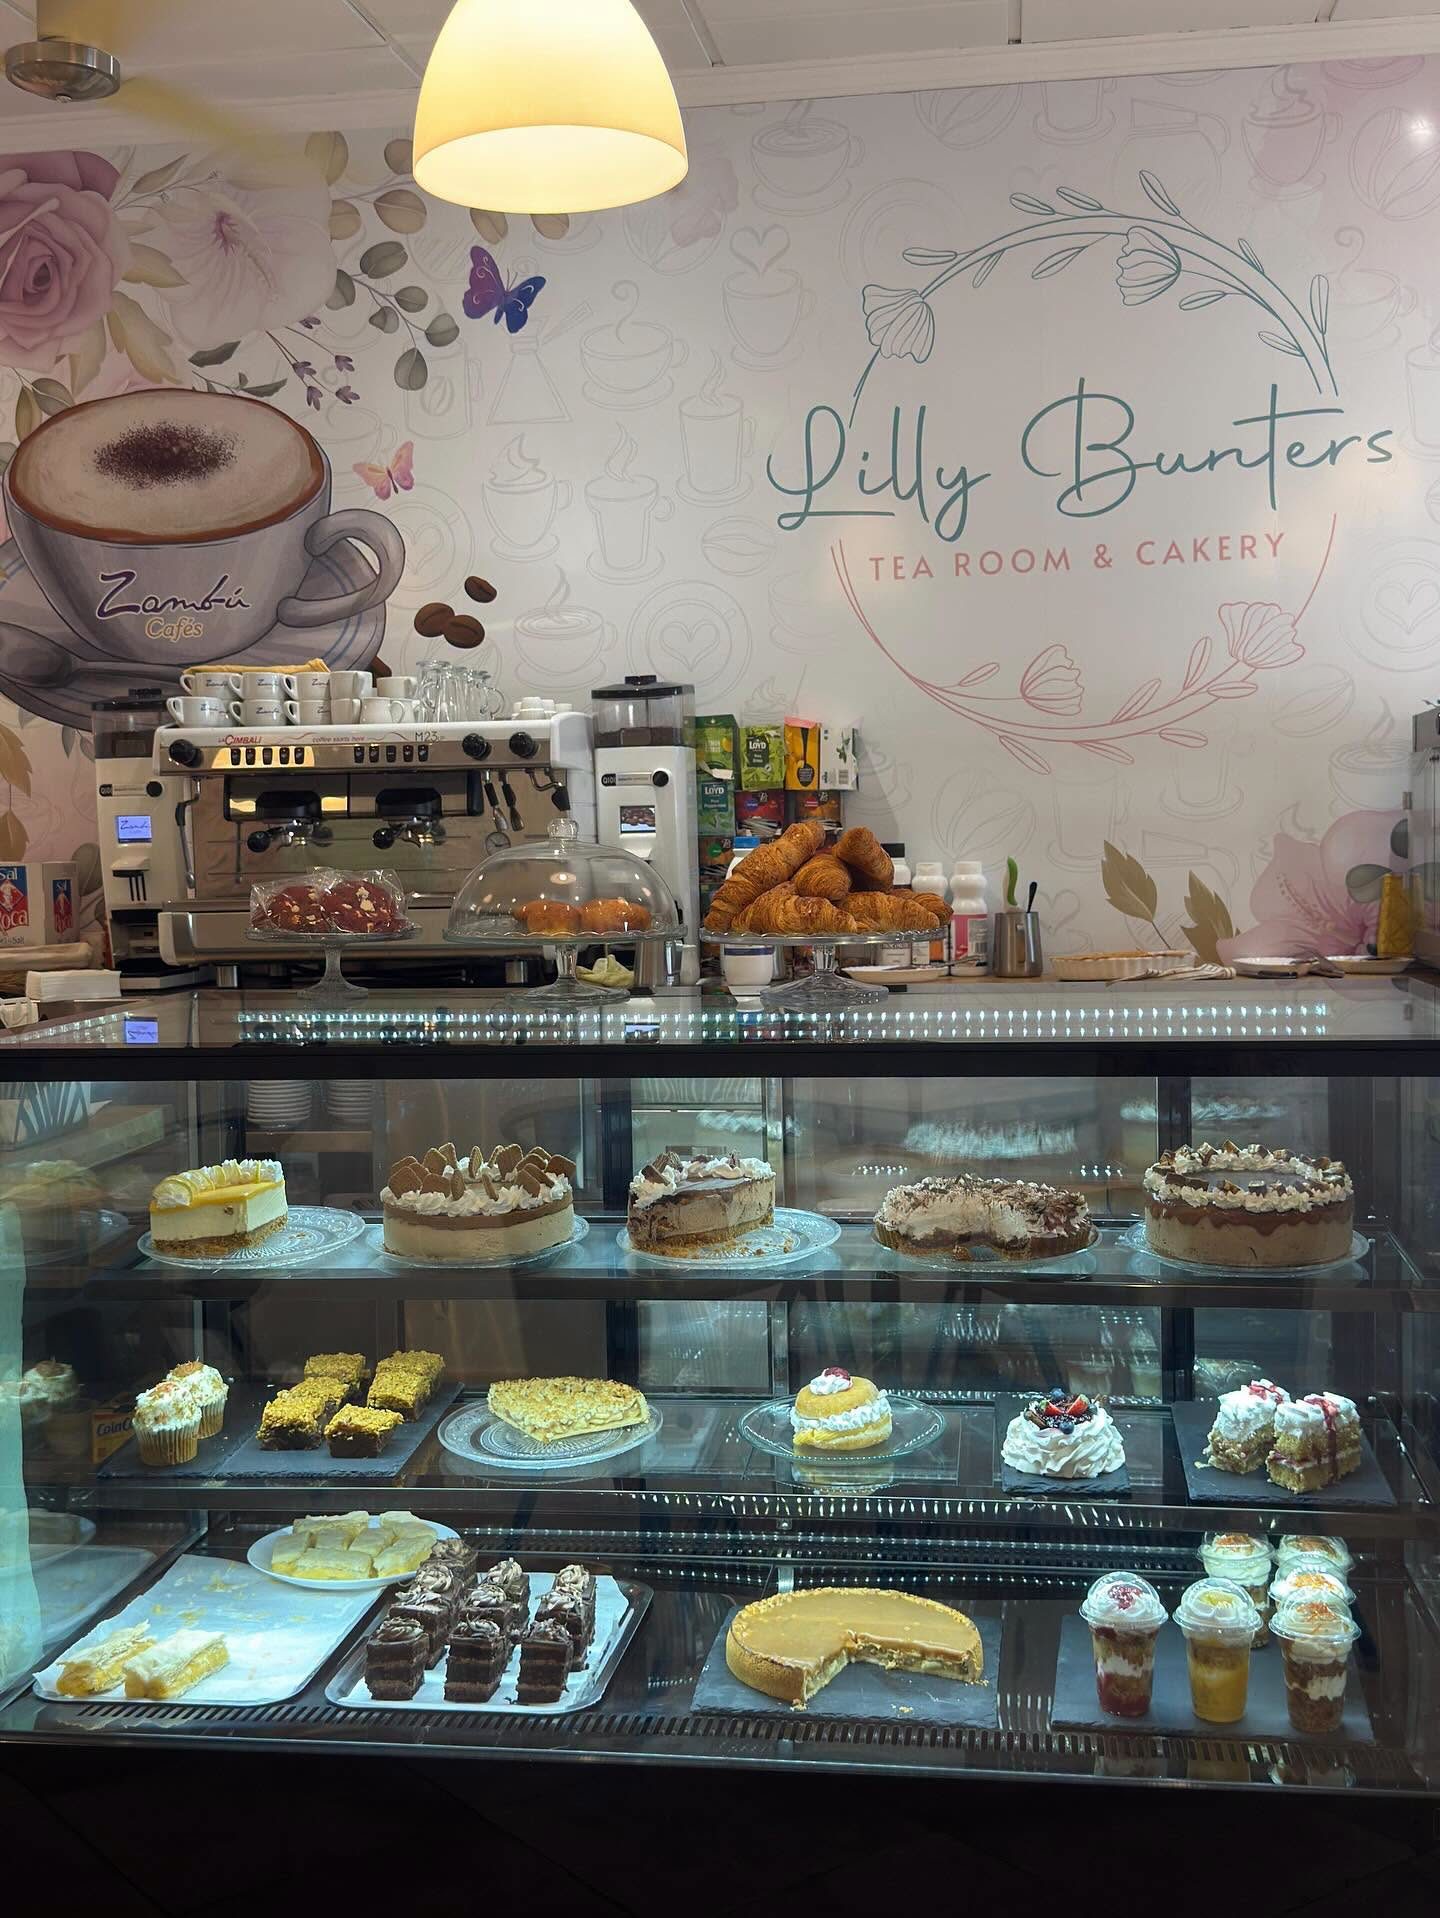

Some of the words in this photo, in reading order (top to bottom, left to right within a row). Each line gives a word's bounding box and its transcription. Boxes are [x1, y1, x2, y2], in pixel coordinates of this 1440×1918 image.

[766, 405, 991, 543] Lilly
[1021, 376, 1395, 519] Bunters
[868, 555, 935, 582] TEA
[953, 546, 1072, 577] ROOM
[1092, 543, 1114, 569] &
[1135, 532, 1286, 567] CAKERY
[146, 618, 203, 642] Cafés
[749, 741, 767, 750] LOYD
[704, 786, 724, 795] LOYD
[0, 910, 28, 929] oca
